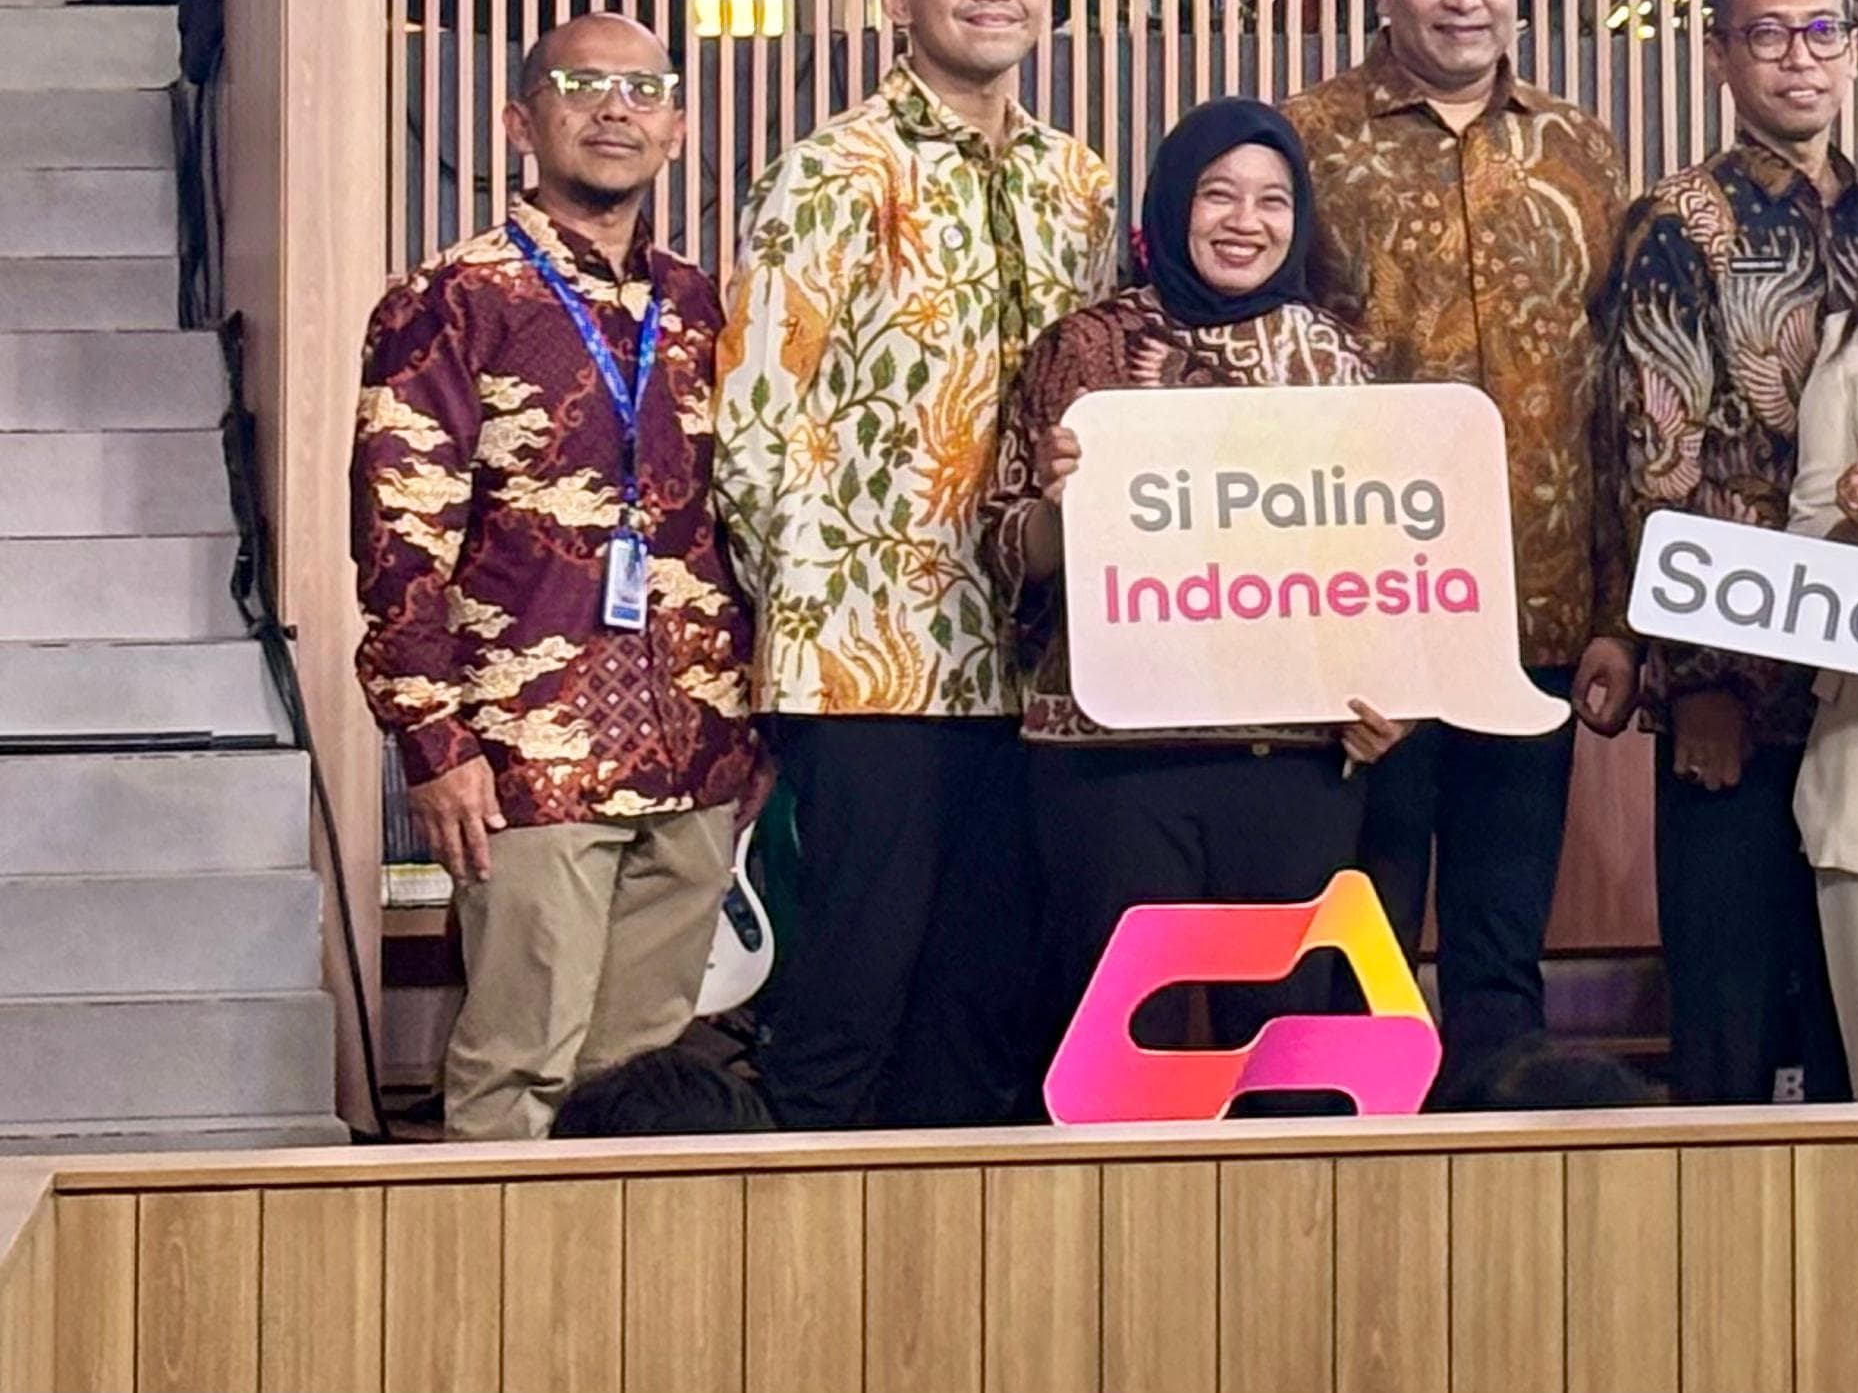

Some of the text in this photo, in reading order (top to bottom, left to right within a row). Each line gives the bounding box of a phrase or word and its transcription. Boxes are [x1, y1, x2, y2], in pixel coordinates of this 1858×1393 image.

[1128, 465, 1446, 542] Si Paling
[1104, 553, 1481, 625] Indonesia
